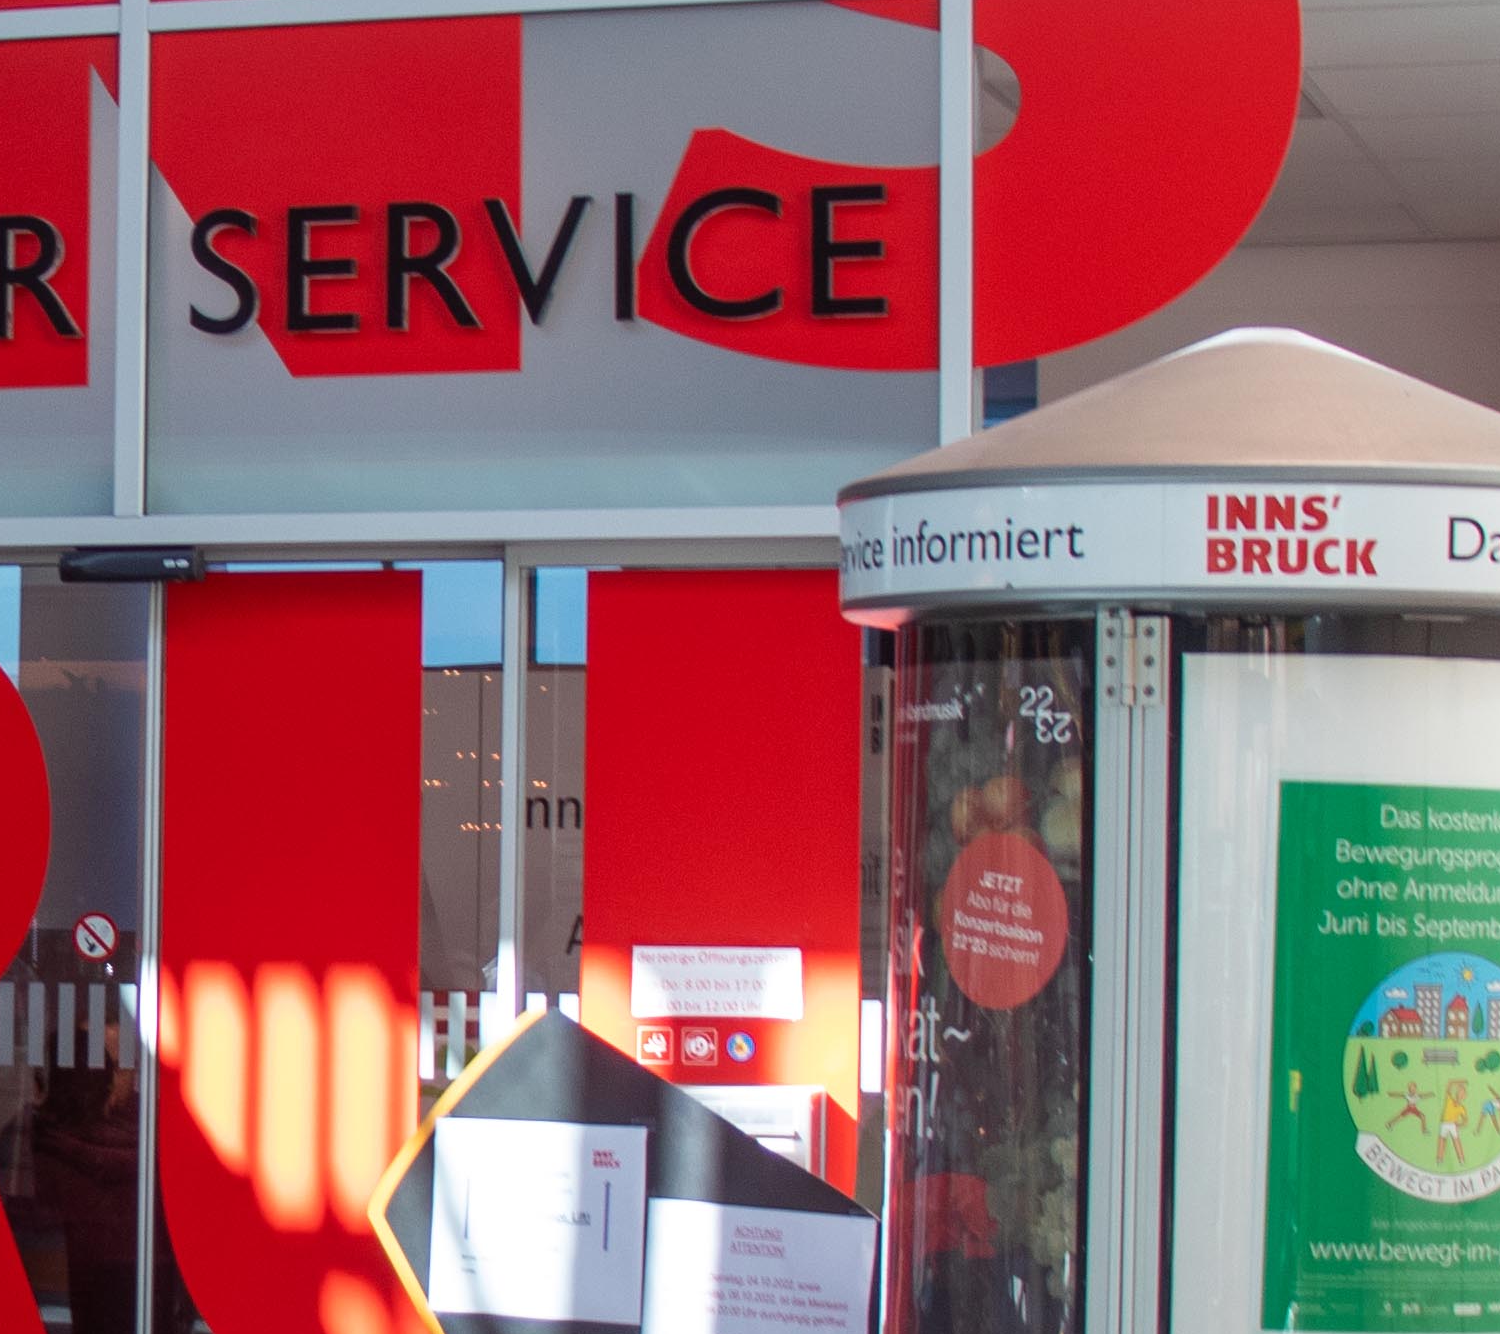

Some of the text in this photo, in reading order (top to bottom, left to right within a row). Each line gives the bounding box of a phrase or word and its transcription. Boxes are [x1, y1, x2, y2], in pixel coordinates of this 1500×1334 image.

[187, 184, 892, 337] SERVICE
[1207, 493, 1341, 532] INNS'
[892, 518, 1085, 566] informiert
[1207, 537, 1377, 576] BRUCK
[1380, 803, 1422, 830] Das
[979, 870, 1024, 894] JETZT
[1336, 876, 1398, 901] ohne
[1317, 910, 1368, 936] Juni
[1376, 913, 1407, 937] bis
[1364, 1143, 1444, 1197] BEWEGT
[1452, 1178, 1475, 1198] IM
